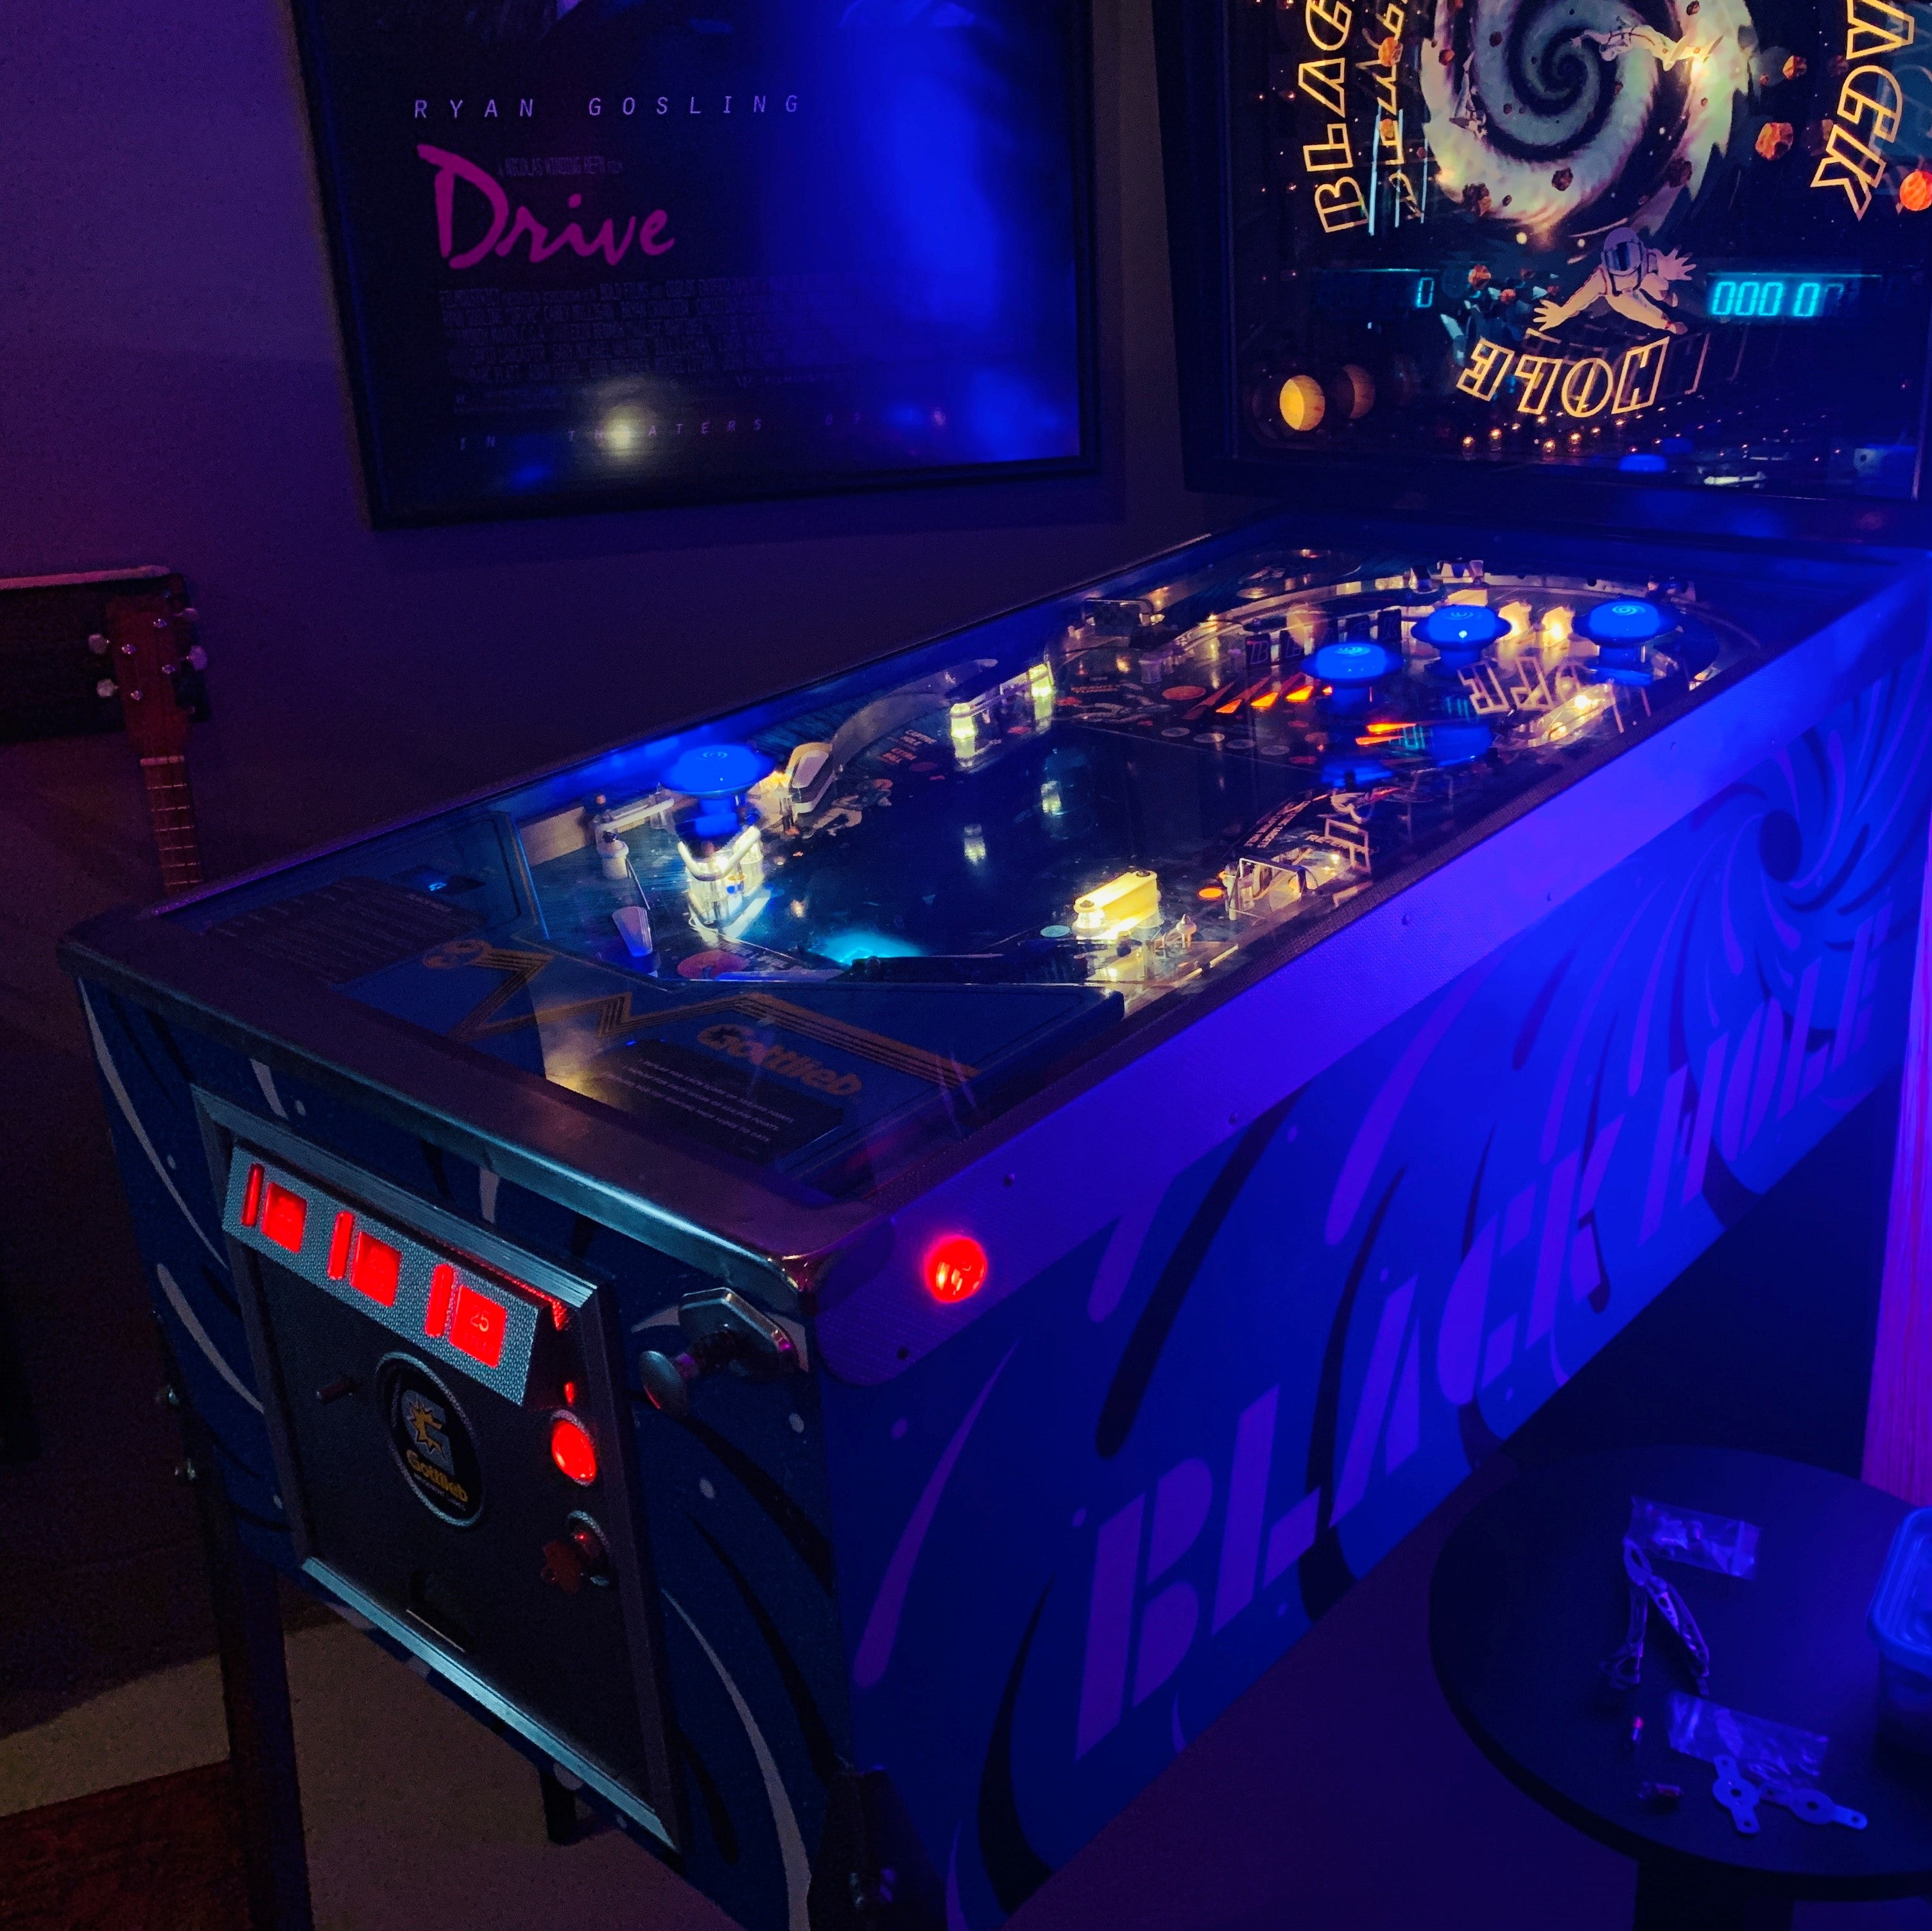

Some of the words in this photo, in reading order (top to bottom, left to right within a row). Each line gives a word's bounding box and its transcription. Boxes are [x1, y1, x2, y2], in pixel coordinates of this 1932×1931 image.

[413, 98, 535, 120] RYAN
[589, 94, 802, 117] GOSLING
[416, 143, 675, 270] Drive
[1456, 336, 1670, 418] HOLE
[458, 435, 497, 451] IN
[567, 418, 763, 444] THATERS
[697, 1023, 862, 1096] Gottlieb
[1076, 1113, 1626, 1764] BLACK
[1638, 904, 1893, 1246] HOLE
[406, 1449, 469, 1502] Gottlieb
